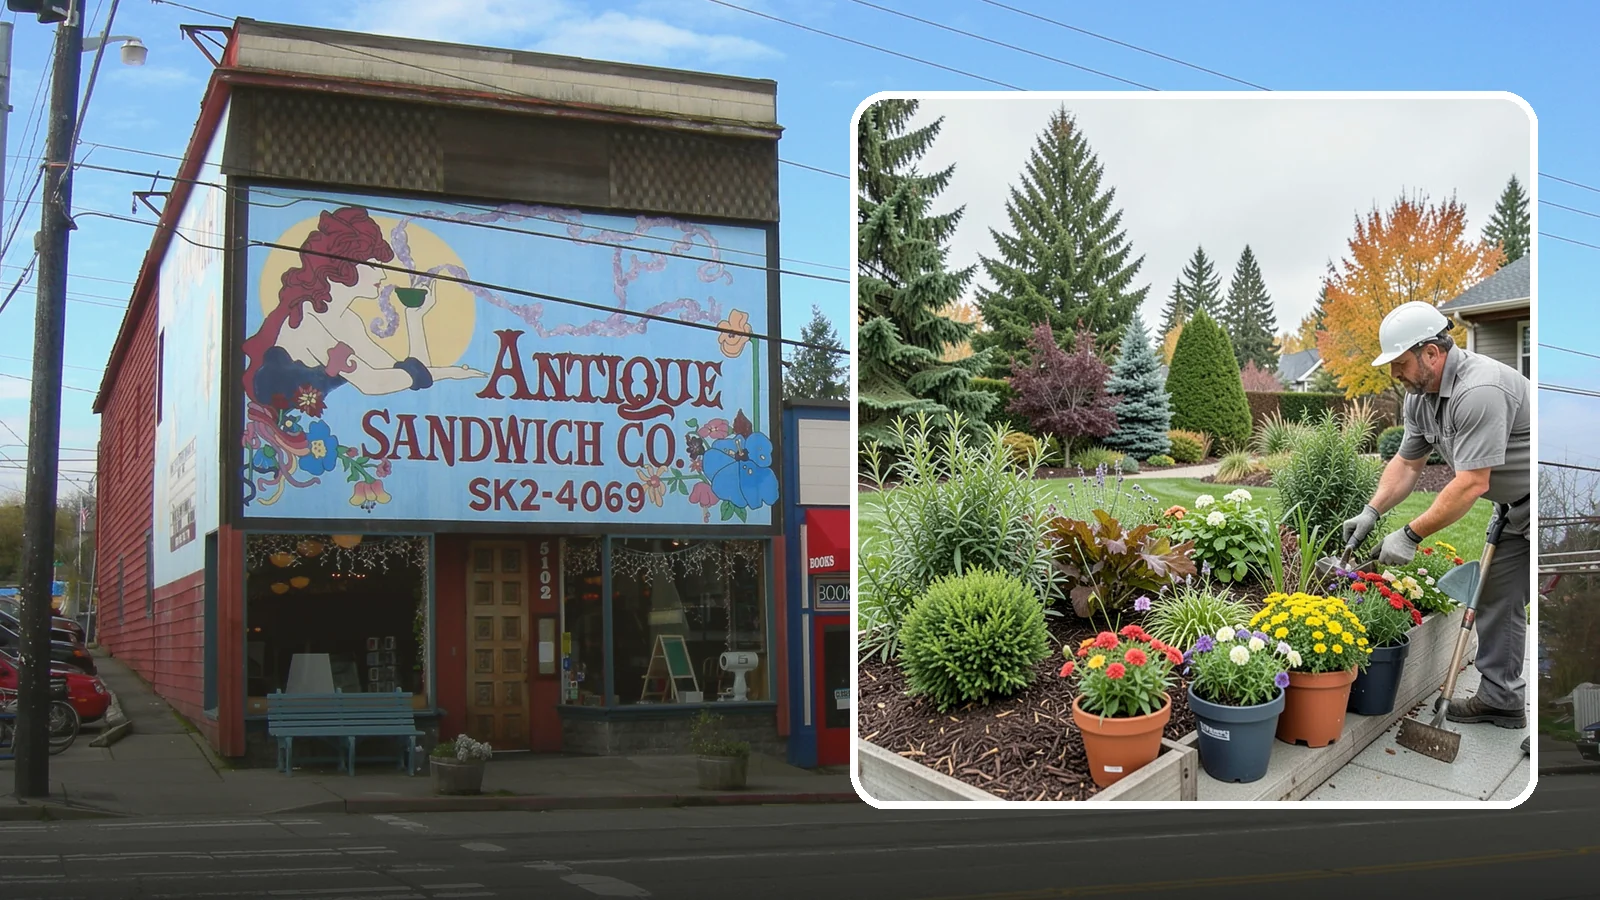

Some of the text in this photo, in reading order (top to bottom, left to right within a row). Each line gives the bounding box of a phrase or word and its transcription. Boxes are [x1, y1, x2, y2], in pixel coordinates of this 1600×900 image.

[361, 408, 685, 469] SANDWICH CO.
[468, 477, 646, 514] SK2-4069
[539, 541, 552, 600] 5102
[809, 555, 835, 569] BOOKS
